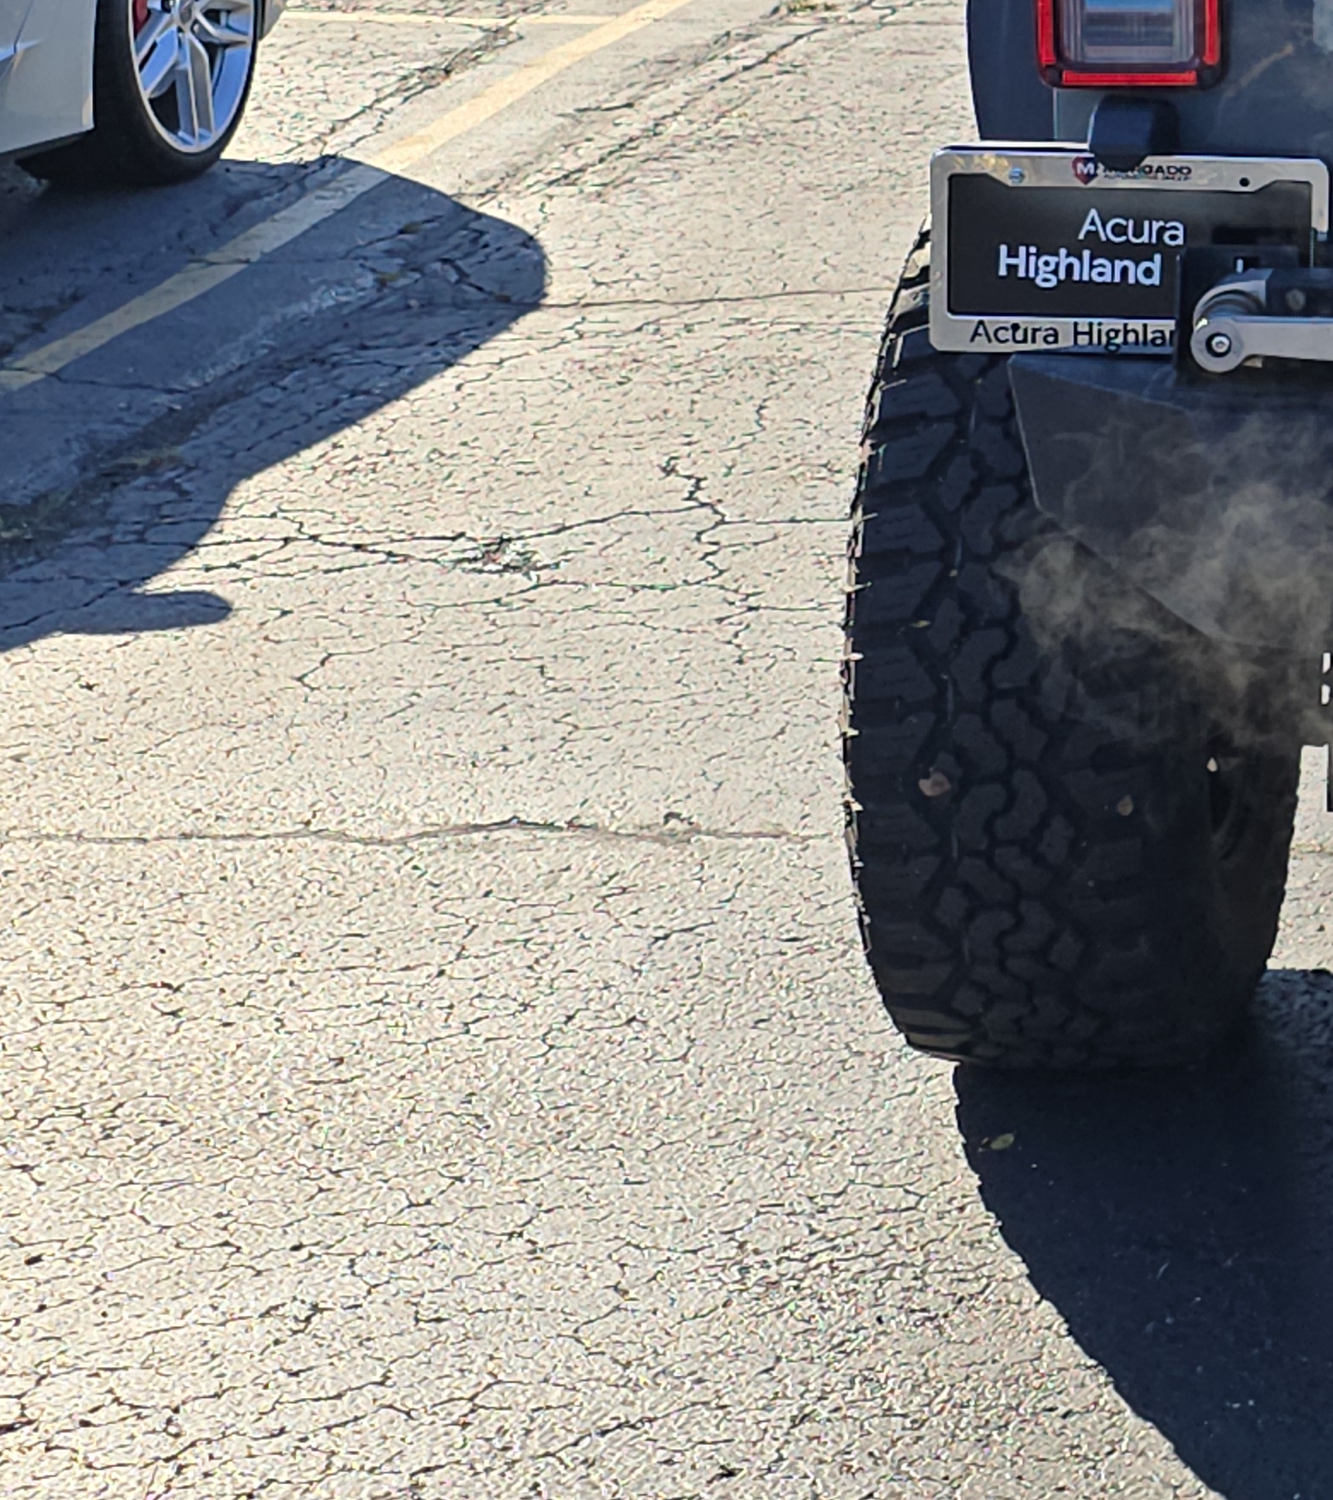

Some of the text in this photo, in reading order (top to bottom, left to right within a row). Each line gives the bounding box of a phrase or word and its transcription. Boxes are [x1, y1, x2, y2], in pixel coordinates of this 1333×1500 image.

[1077, 207, 1185, 246] Acura
[998, 244, 1162, 288] Highland
[969, 319, 1059, 345] Acura
